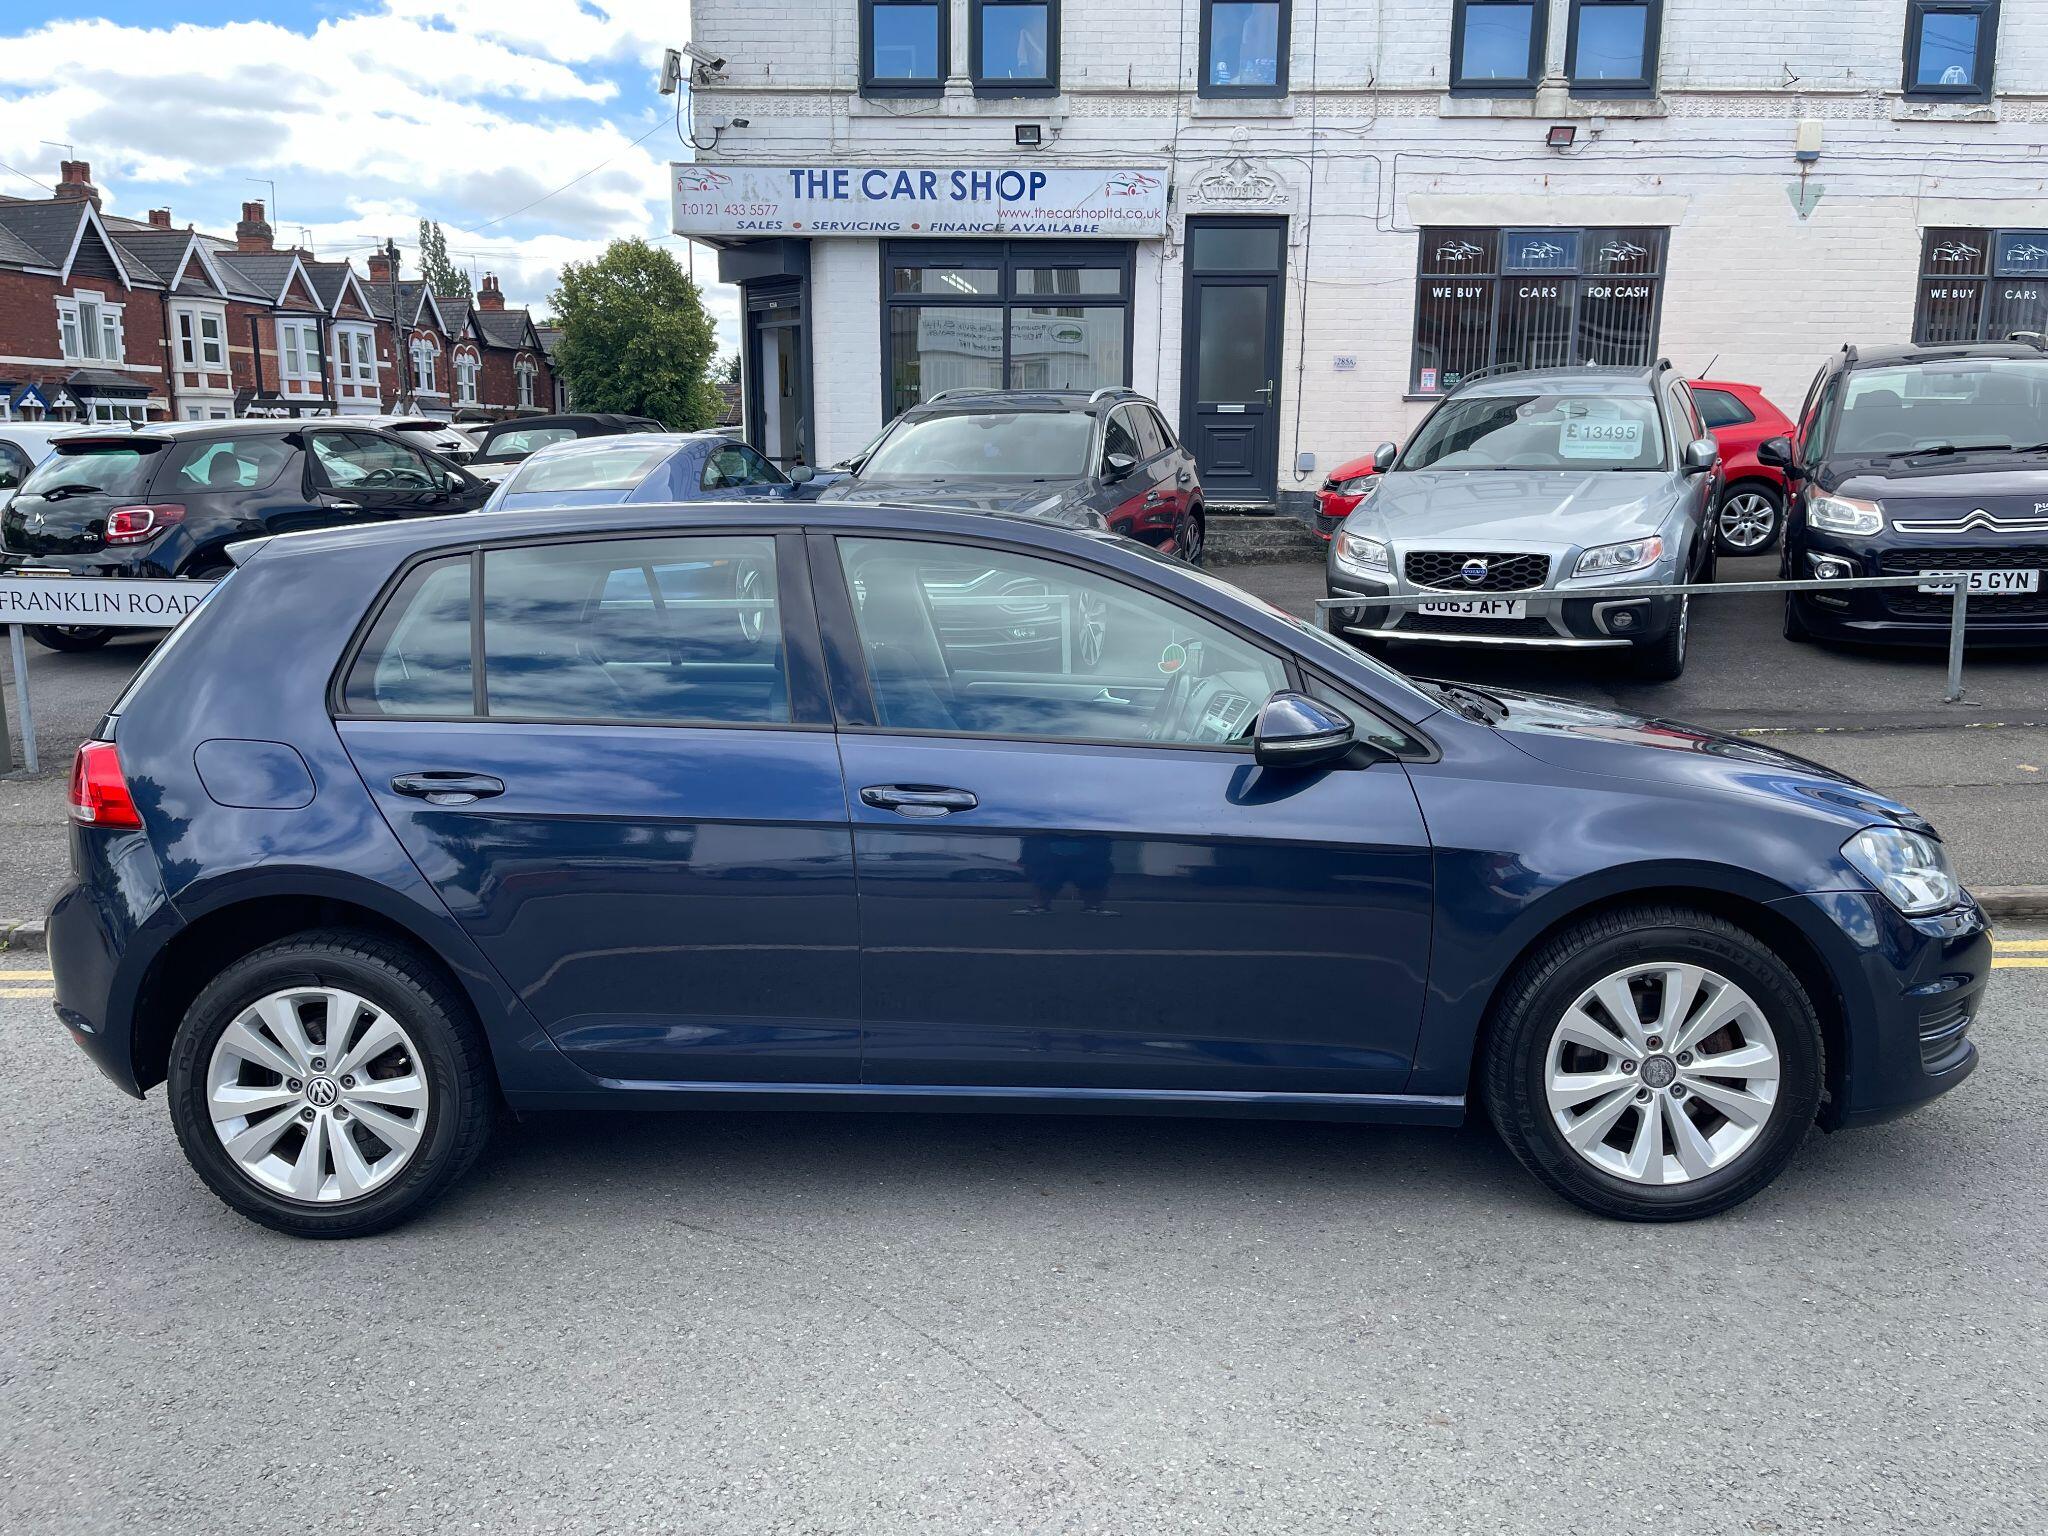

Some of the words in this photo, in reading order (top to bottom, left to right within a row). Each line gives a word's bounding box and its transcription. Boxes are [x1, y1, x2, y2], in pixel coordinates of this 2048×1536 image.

[789, 169, 849, 199] THE
[861, 169, 938, 200] CAR
[950, 170, 1047, 201] SHOP
[682, 203, 718, 215] T:0121
[724, 203, 746, 216] 433
[750, 204, 778, 216] 5577
[997, 207, 1161, 221] www.thecarshopltd.co.uk
[736, 220, 783, 230] SALES
[811, 221, 901, 231] SERVICING
[930, 222, 1005, 232] FINANCE
[1010, 223, 1099, 233] AVAILABLE
[1432, 287, 1451, 298] WE
[1457, 287, 1483, 298] BUY
[1519, 287, 1557, 298] CARS
[1587, 287, 1612, 298] FOR
[1615, 286, 1649, 298] CASH
[1930, 289, 1947, 298] WE
[1952, 289, 1974, 298] BUY
[2004, 290, 2037, 299] CARS
[1988, 572, 2029, 589] GYN
[0, 591, 121, 612] FRANKLIN
[128, 593, 200, 614] ROAD
[1480, 599, 1517, 615] AFY
